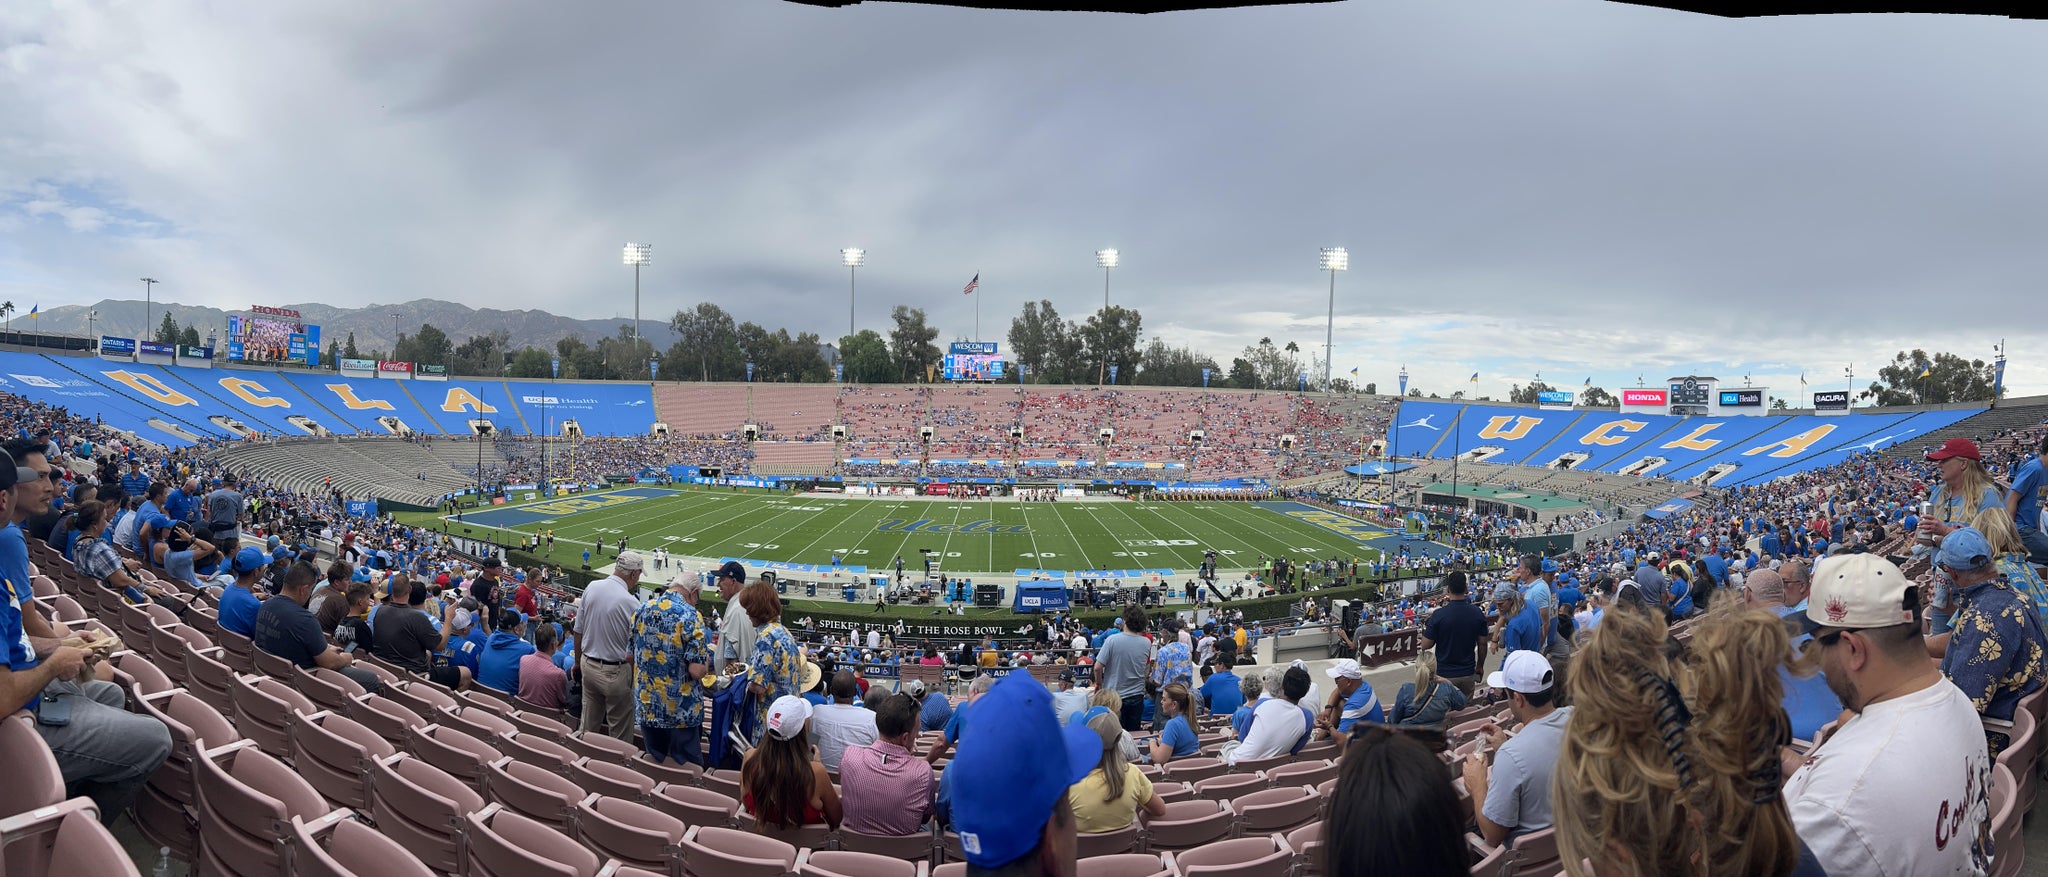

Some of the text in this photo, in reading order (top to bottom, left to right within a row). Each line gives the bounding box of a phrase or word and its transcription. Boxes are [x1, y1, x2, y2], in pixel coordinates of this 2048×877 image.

[251, 304, 302, 318] HONDA
[102, 338, 125, 346] ONTARIO
[382, 361, 408, 371] Coca-Cola
[1627, 393, 1662, 401] HONDA
[1739, 394, 1759, 402] Health
[1821, 394, 1846, 402] ACURA
[351, 503, 366, 511] SEAT
[917, 626, 941, 635] THE
[944, 626, 971, 635] ROSE
[975, 626, 1006, 635] BOWL
[1376, 635, 1412, 656] 1-41
